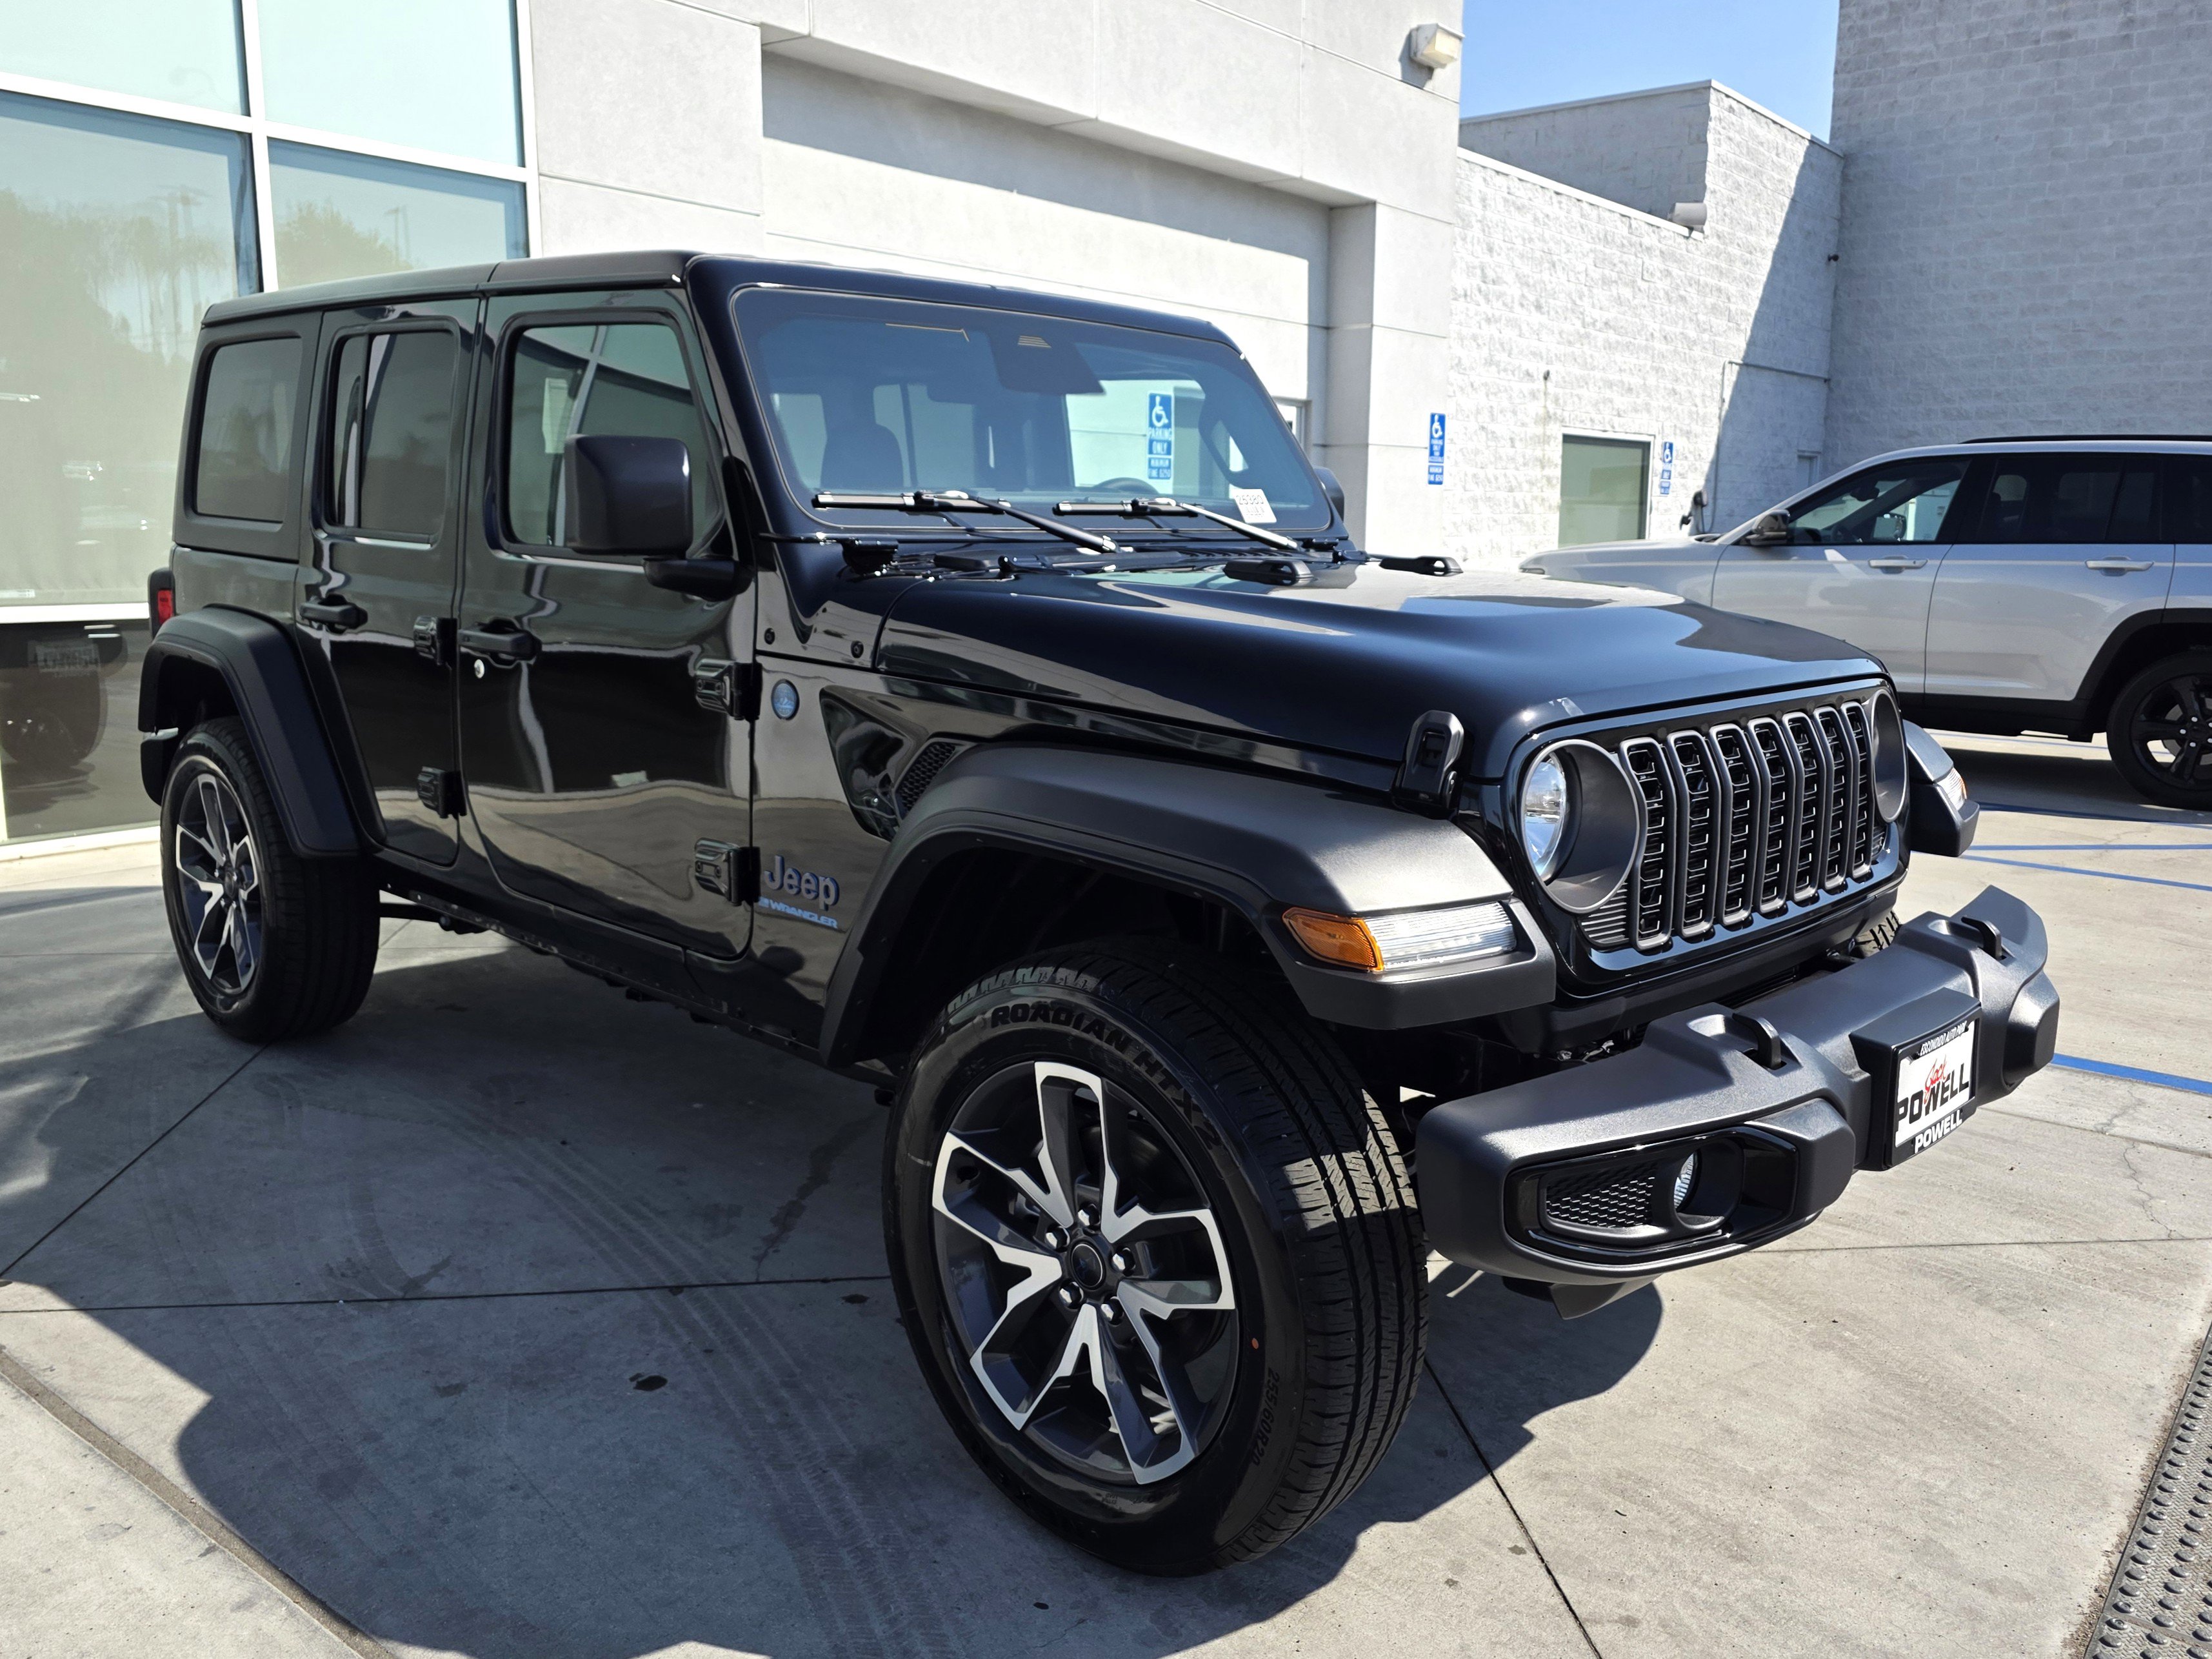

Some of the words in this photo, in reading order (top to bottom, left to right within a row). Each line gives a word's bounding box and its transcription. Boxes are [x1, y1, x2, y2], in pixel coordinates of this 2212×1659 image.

[1148, 427, 1172, 441] PARKING
[1152, 441, 1168, 454] ONLY
[764, 855, 839, 911] Jeep
[769, 900, 838, 929] WRANGLER
[991, 1001, 1133, 1053] ROADIAN
[1897, 1063, 1969, 1124] POWELL
[1915, 1109, 1962, 1154] POWELL
[1253, 1367, 1280, 1466] 255/60R20
